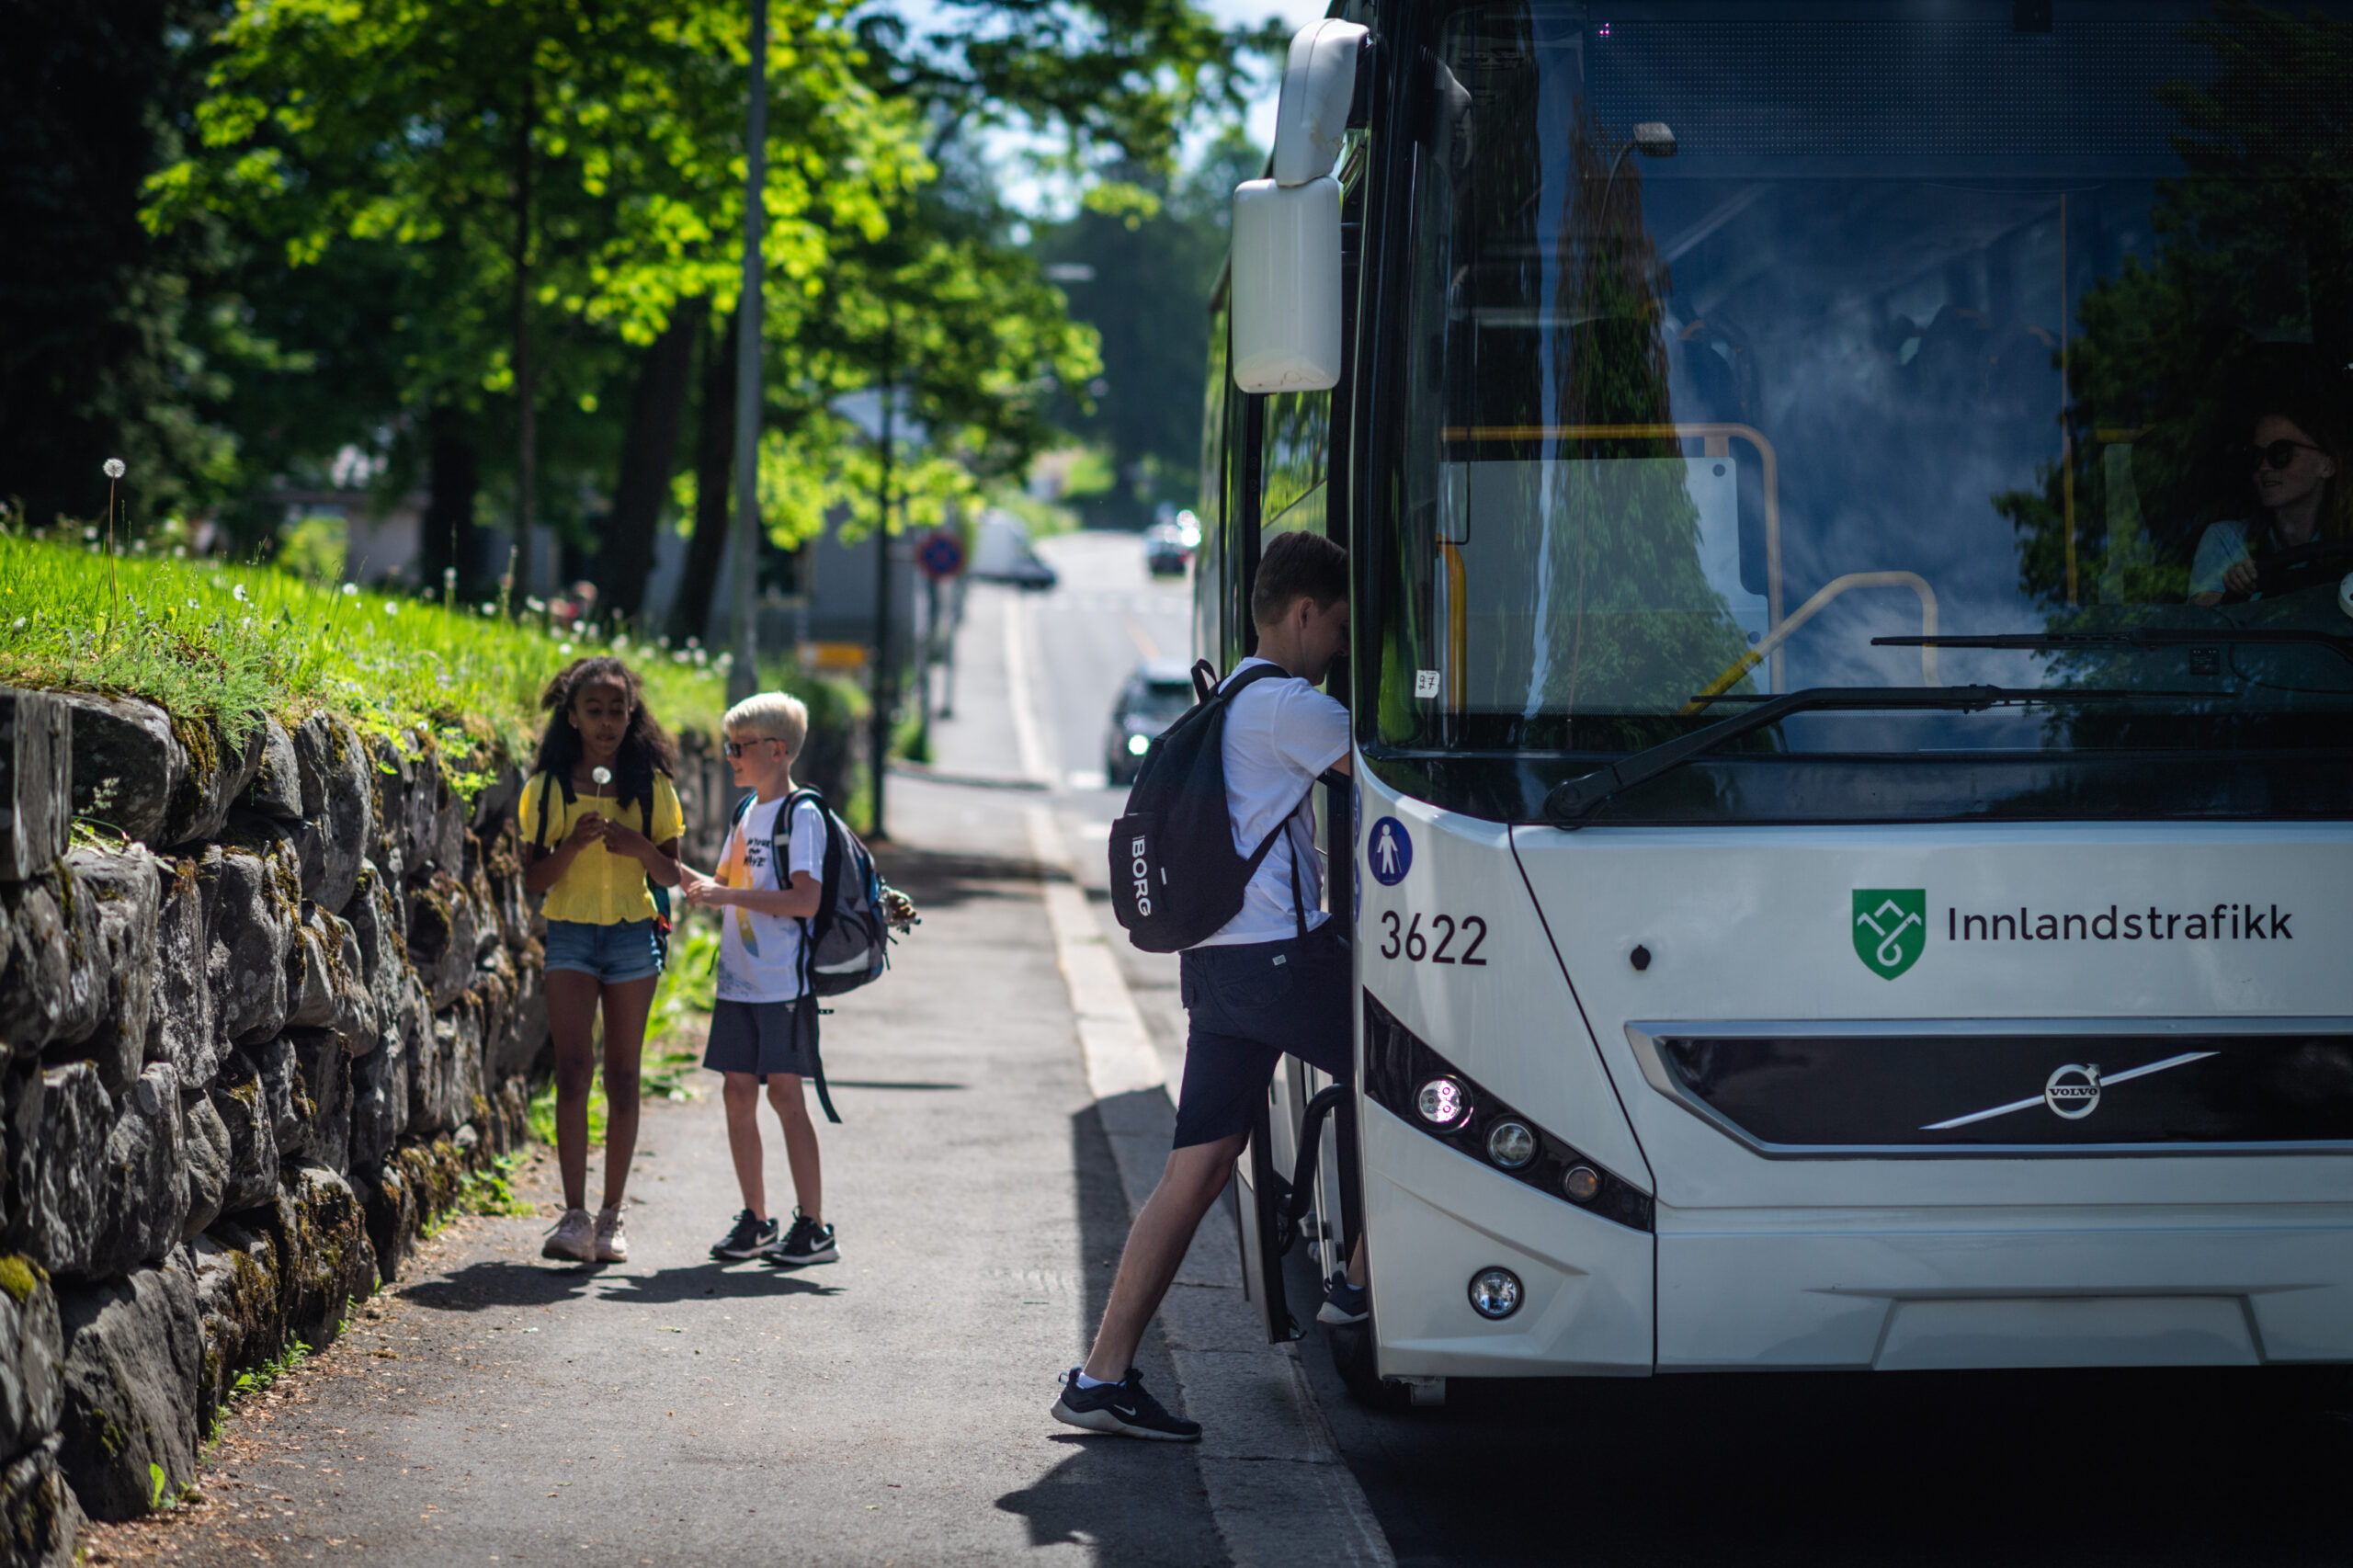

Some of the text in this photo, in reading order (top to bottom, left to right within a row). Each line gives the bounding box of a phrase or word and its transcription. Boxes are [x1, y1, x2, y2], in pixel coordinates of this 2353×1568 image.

[1132, 838, 1151, 916] BORG
[1381, 910, 1487, 966] 3622
[1949, 903, 2294, 941] Innlandstrafikk
[2049, 1087, 2097, 1096] VOLVO
